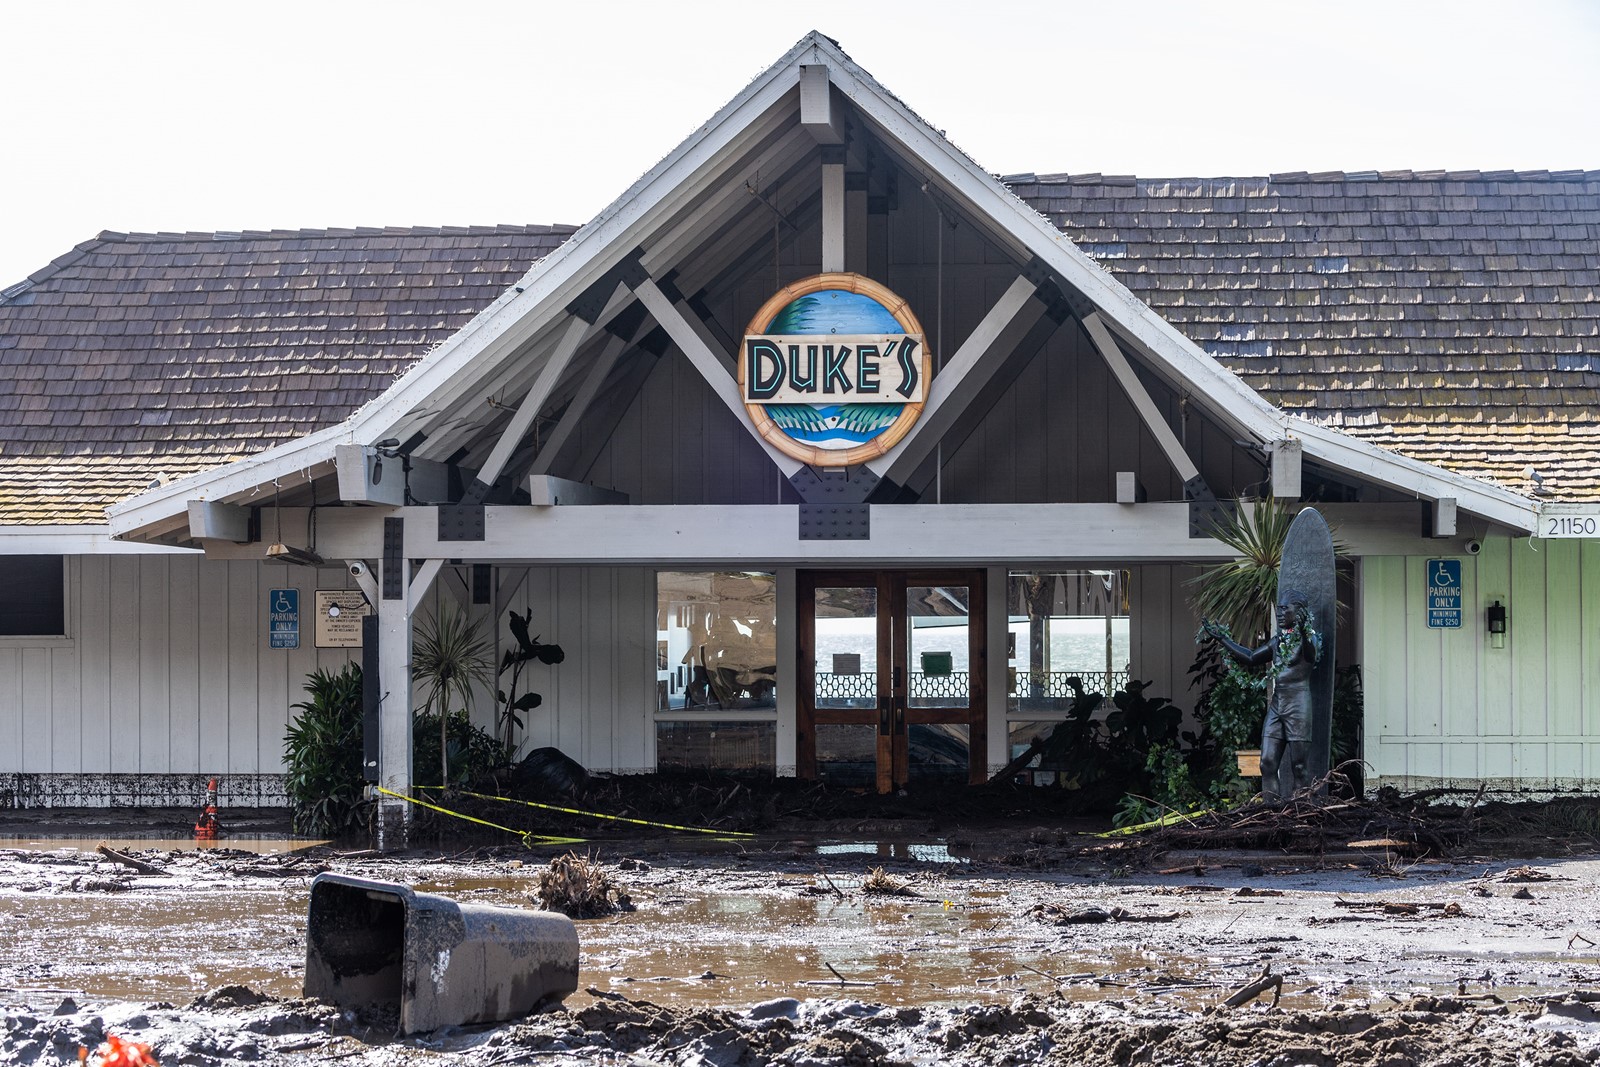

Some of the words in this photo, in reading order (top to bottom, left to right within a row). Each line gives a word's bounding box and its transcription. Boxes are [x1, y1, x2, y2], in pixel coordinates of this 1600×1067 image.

[747, 336, 919, 400] DUKE'S
[1548, 518, 1596, 535] 21150
[1430, 587, 1460, 597] PARKING
[1435, 598, 1454, 607] ONLY
[271, 613, 297, 621] PARKING
